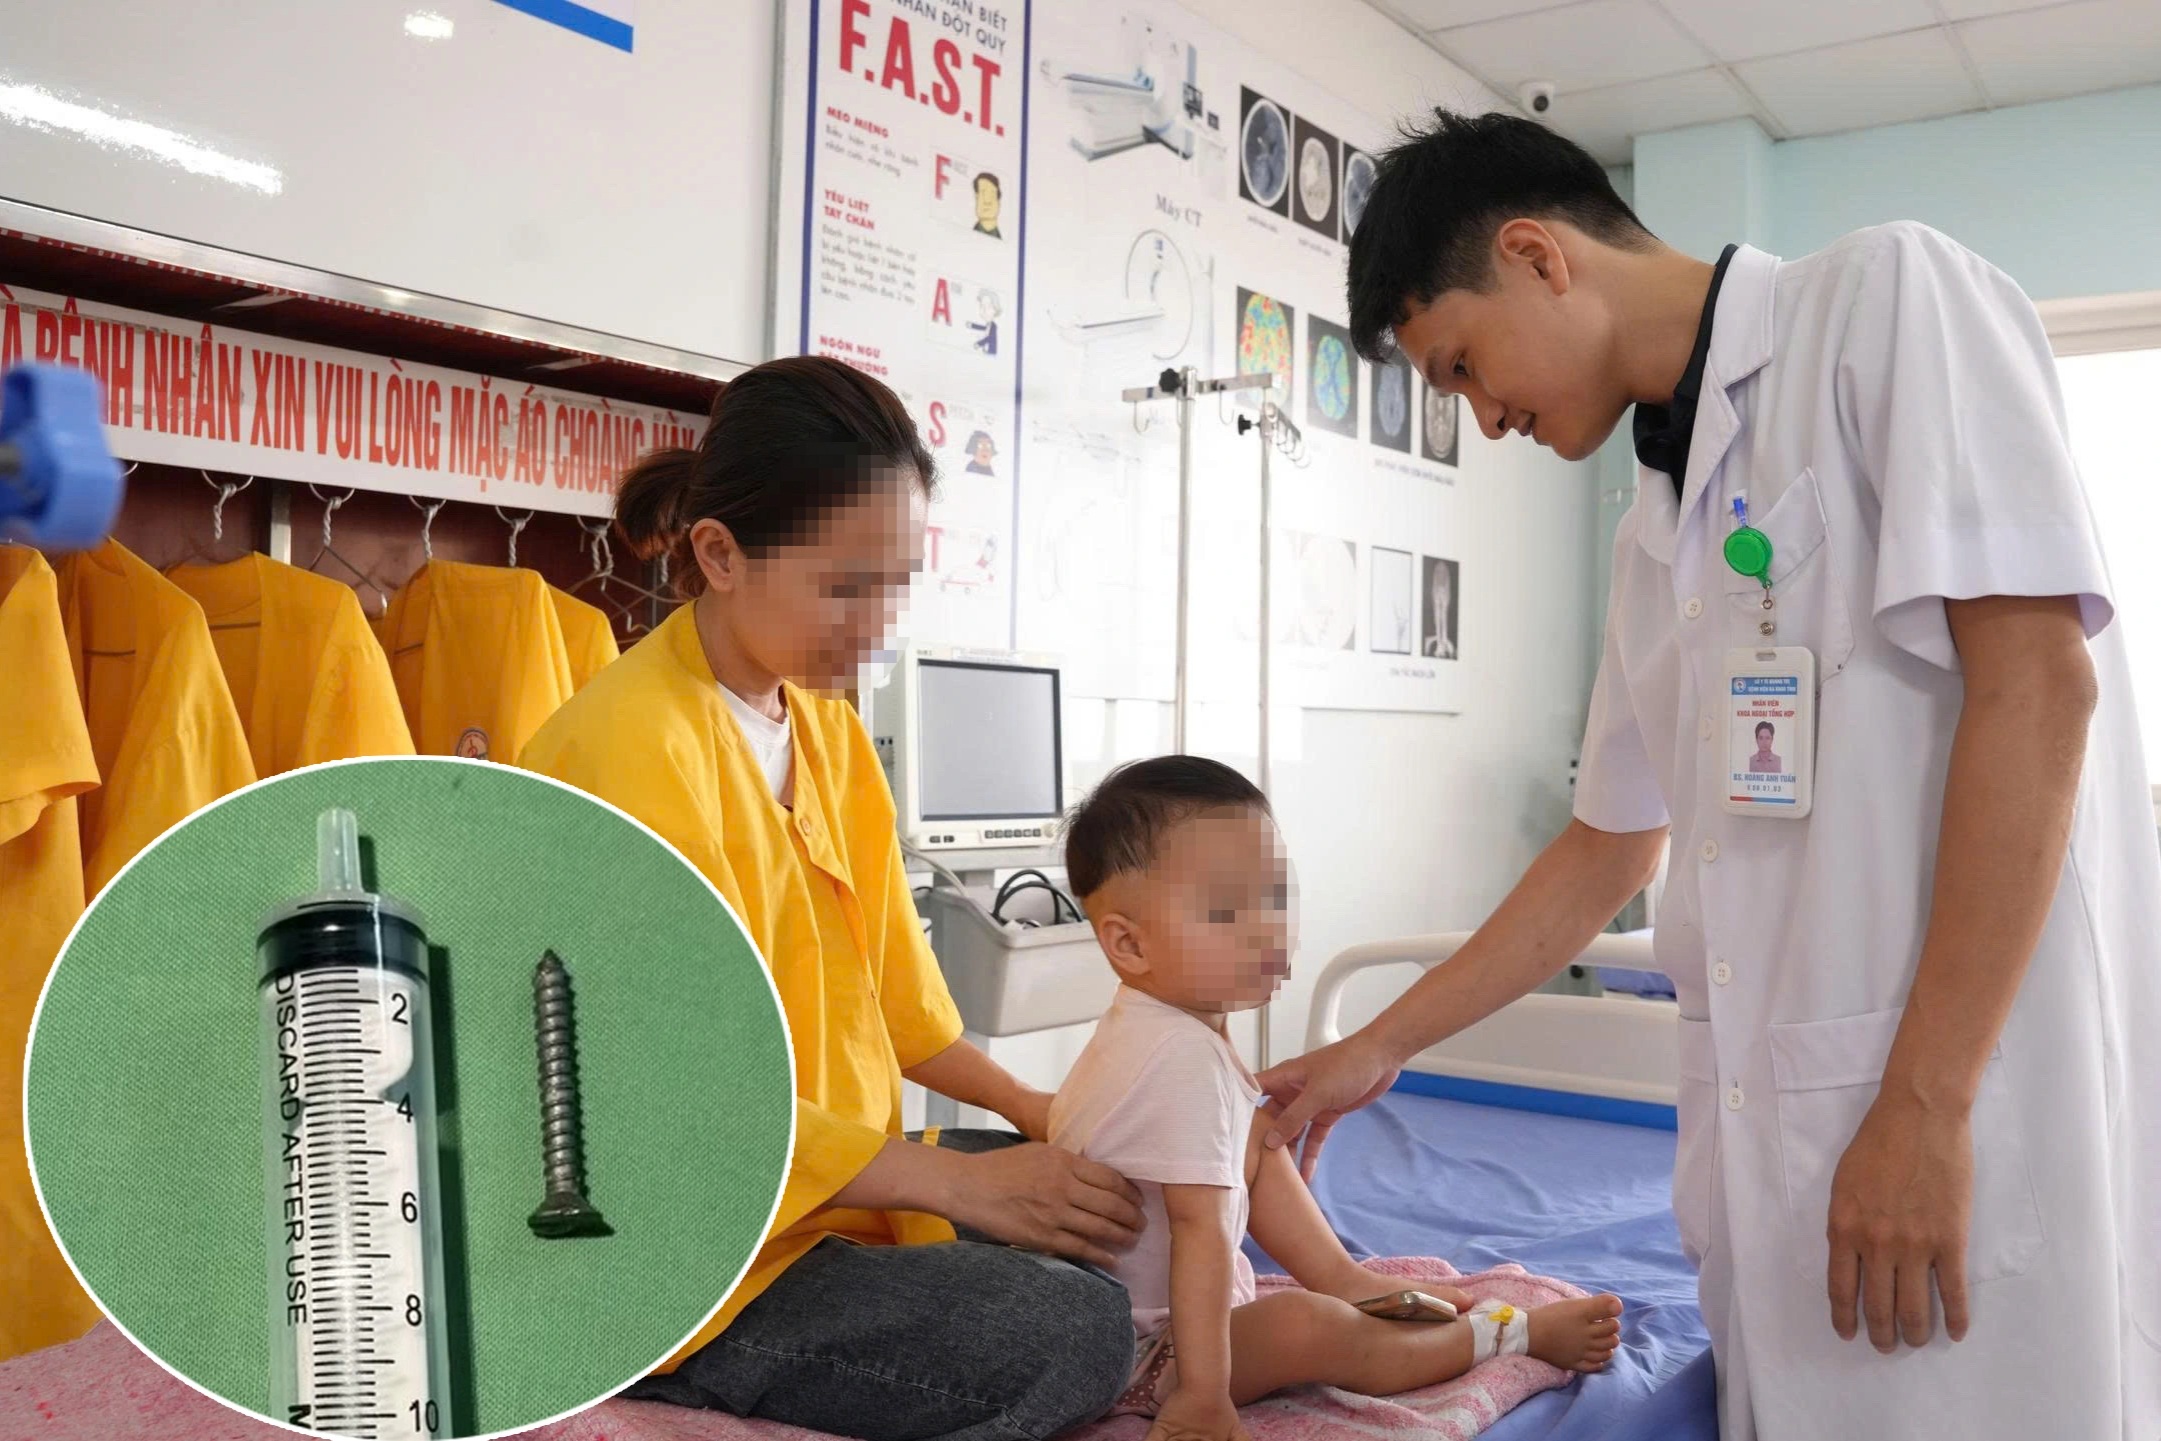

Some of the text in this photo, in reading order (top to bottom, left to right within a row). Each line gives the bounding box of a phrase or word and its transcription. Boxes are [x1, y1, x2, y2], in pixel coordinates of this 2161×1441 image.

[839, 0, 1004, 137] F.A.S.T.
[144, 324, 242, 442] NHÂN
[251, 349, 305, 452] XIN
[315, 361, 363, 460] VUI
[369, 357, 441, 471] LÒNG
[450, 375, 509, 492] MẶC
[514, 385, 547, 486] ÁO
[391, 993, 409, 1025] 2
[397, 1093, 414, 1123] 4
[275, 970, 307, 1327] DISCARD AFTER USE
[402, 1191, 418, 1223] 6
[405, 1294, 422, 1326] 8
[409, 1399, 439, 1432] 10
